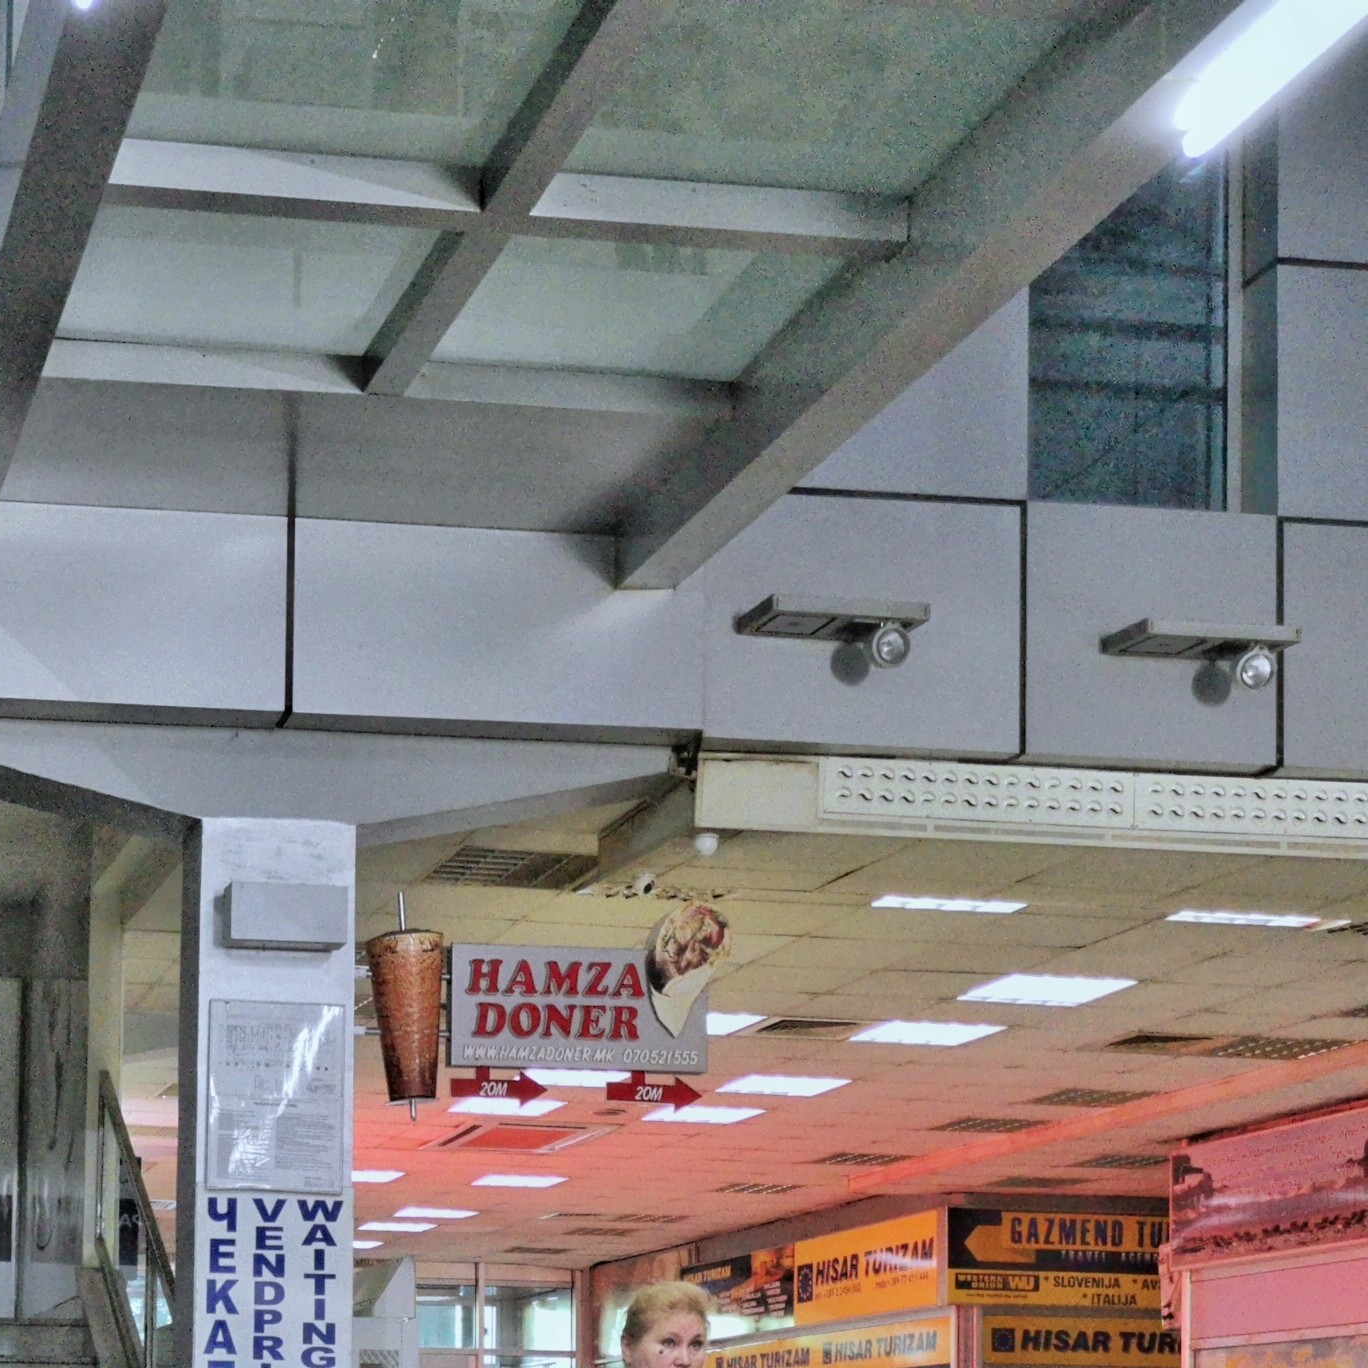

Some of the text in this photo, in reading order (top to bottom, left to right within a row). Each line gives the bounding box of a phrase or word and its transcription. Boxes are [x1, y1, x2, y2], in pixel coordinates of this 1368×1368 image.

[465, 959, 645, 998] HAMZA
[473, 1003, 640, 1041] DONER
[462, 1044, 699, 1065] WWW.HAMZADONER.MK 070521555
[479, 1082, 508, 1097] 20M
[635, 1086, 663, 1101] 20M
[1010, 1217, 1123, 1247] GAZMEND
[815, 1254, 859, 1286] HISAR
[1053, 1276, 1120, 1289] SLOVENIJA
[1092, 1293, 1137, 1306] ITALIJA
[835, 1330, 938, 1362] HISAR TURIZAM
[1021, 1329, 1111, 1353] HISAR
[760, 1347, 810, 1368] TURIZAM
